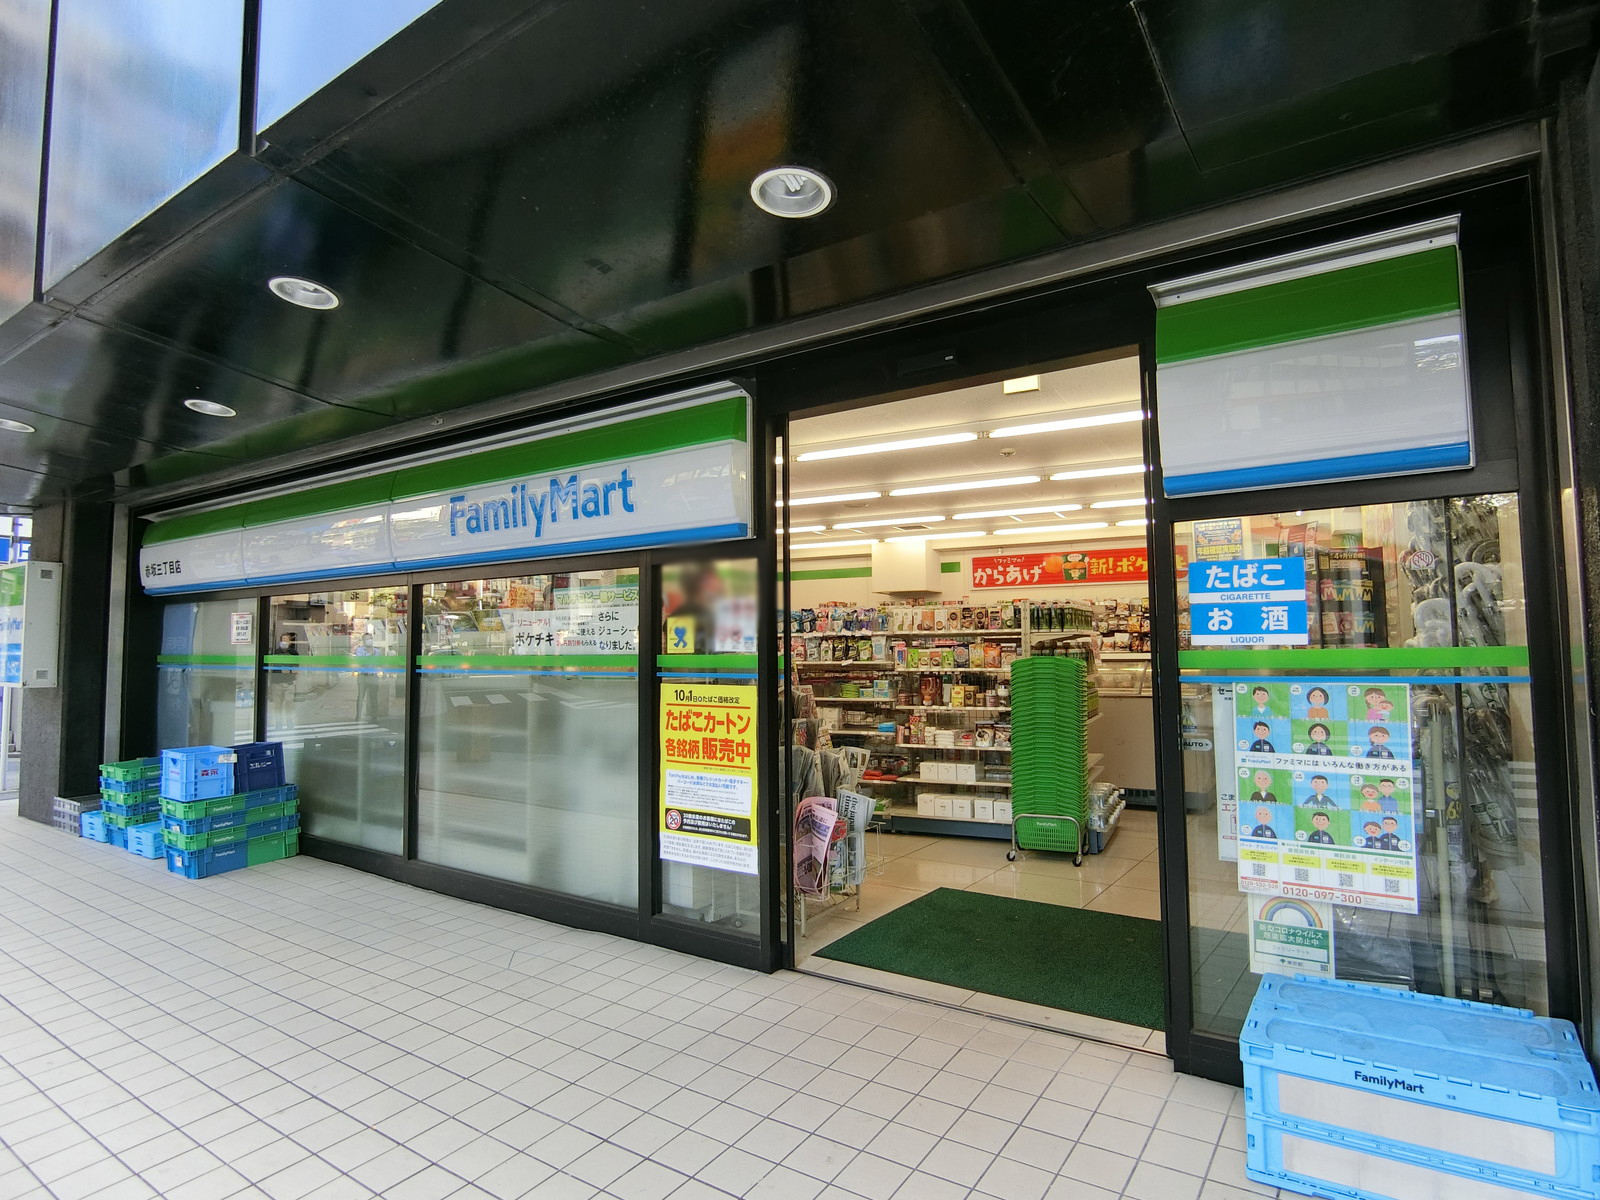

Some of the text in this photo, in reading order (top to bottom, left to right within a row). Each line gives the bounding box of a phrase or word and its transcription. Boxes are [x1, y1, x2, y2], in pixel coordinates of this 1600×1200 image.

[449, 468, 635, 538] FamilyMart
[144, 560, 182, 578] 赤坂三丁目店
[973, 561, 1047, 586] からあげ
[1205, 562, 1286, 589] たばこ
[1220, 592, 1271, 601] CIGARETTE
[598, 610, 620, 622] さらに
[515, 631, 554, 647] ポケチキ
[599, 640, 637, 652] なりました。
[1217, 686, 1233, 695] セー
[665, 709, 751, 735] たばこカートン
[665, 737, 751, 764] 各銘柄 販売中
[1282, 886, 1362, 905] 0120-097-300
[1259, 923, 1323, 940] 新型コロナウイルス
[1354, 1070, 1425, 1094] FamilyMart
